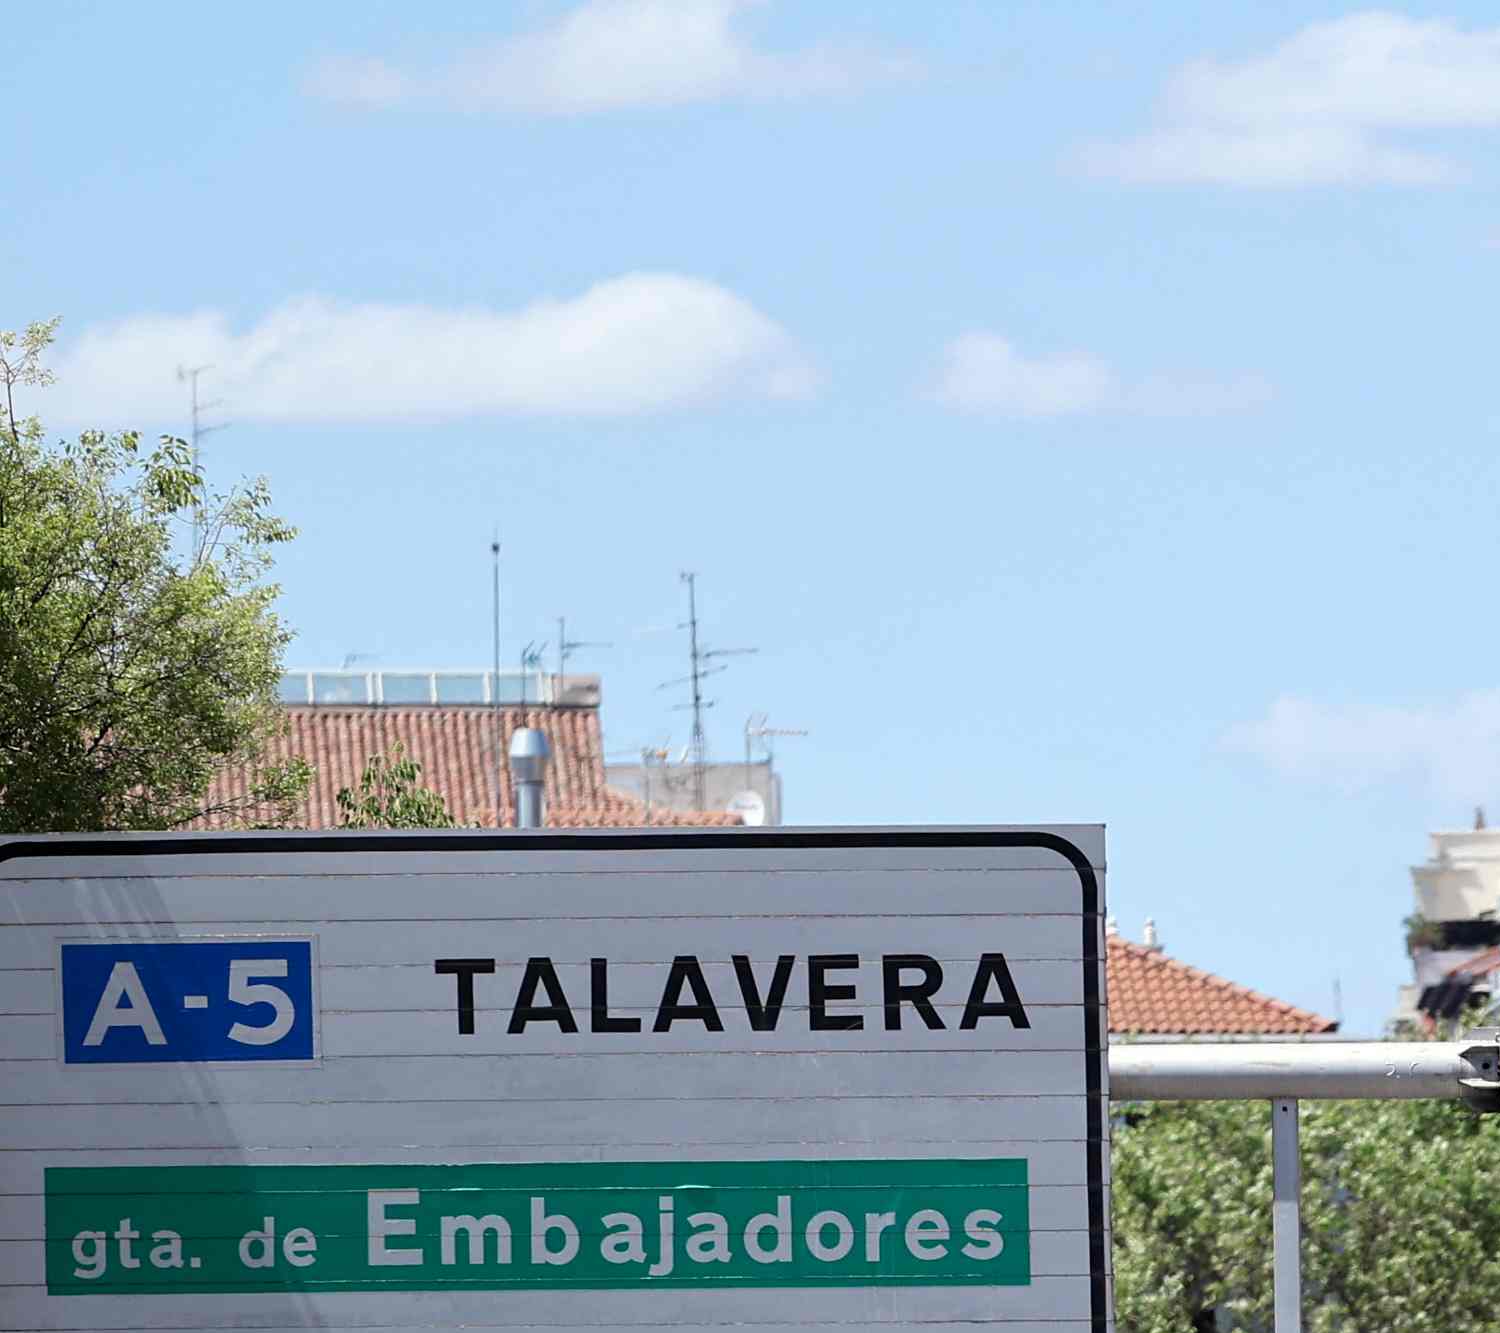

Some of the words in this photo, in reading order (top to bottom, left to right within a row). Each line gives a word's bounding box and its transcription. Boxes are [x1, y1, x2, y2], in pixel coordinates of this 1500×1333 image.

[82, 957, 295, 1049] A-5
[433, 951, 1032, 1035] TALAVERA
[71, 1217, 203, 1280] gta.
[238, 1214, 317, 1269] de
[366, 1186, 1007, 1279] Embajadores
